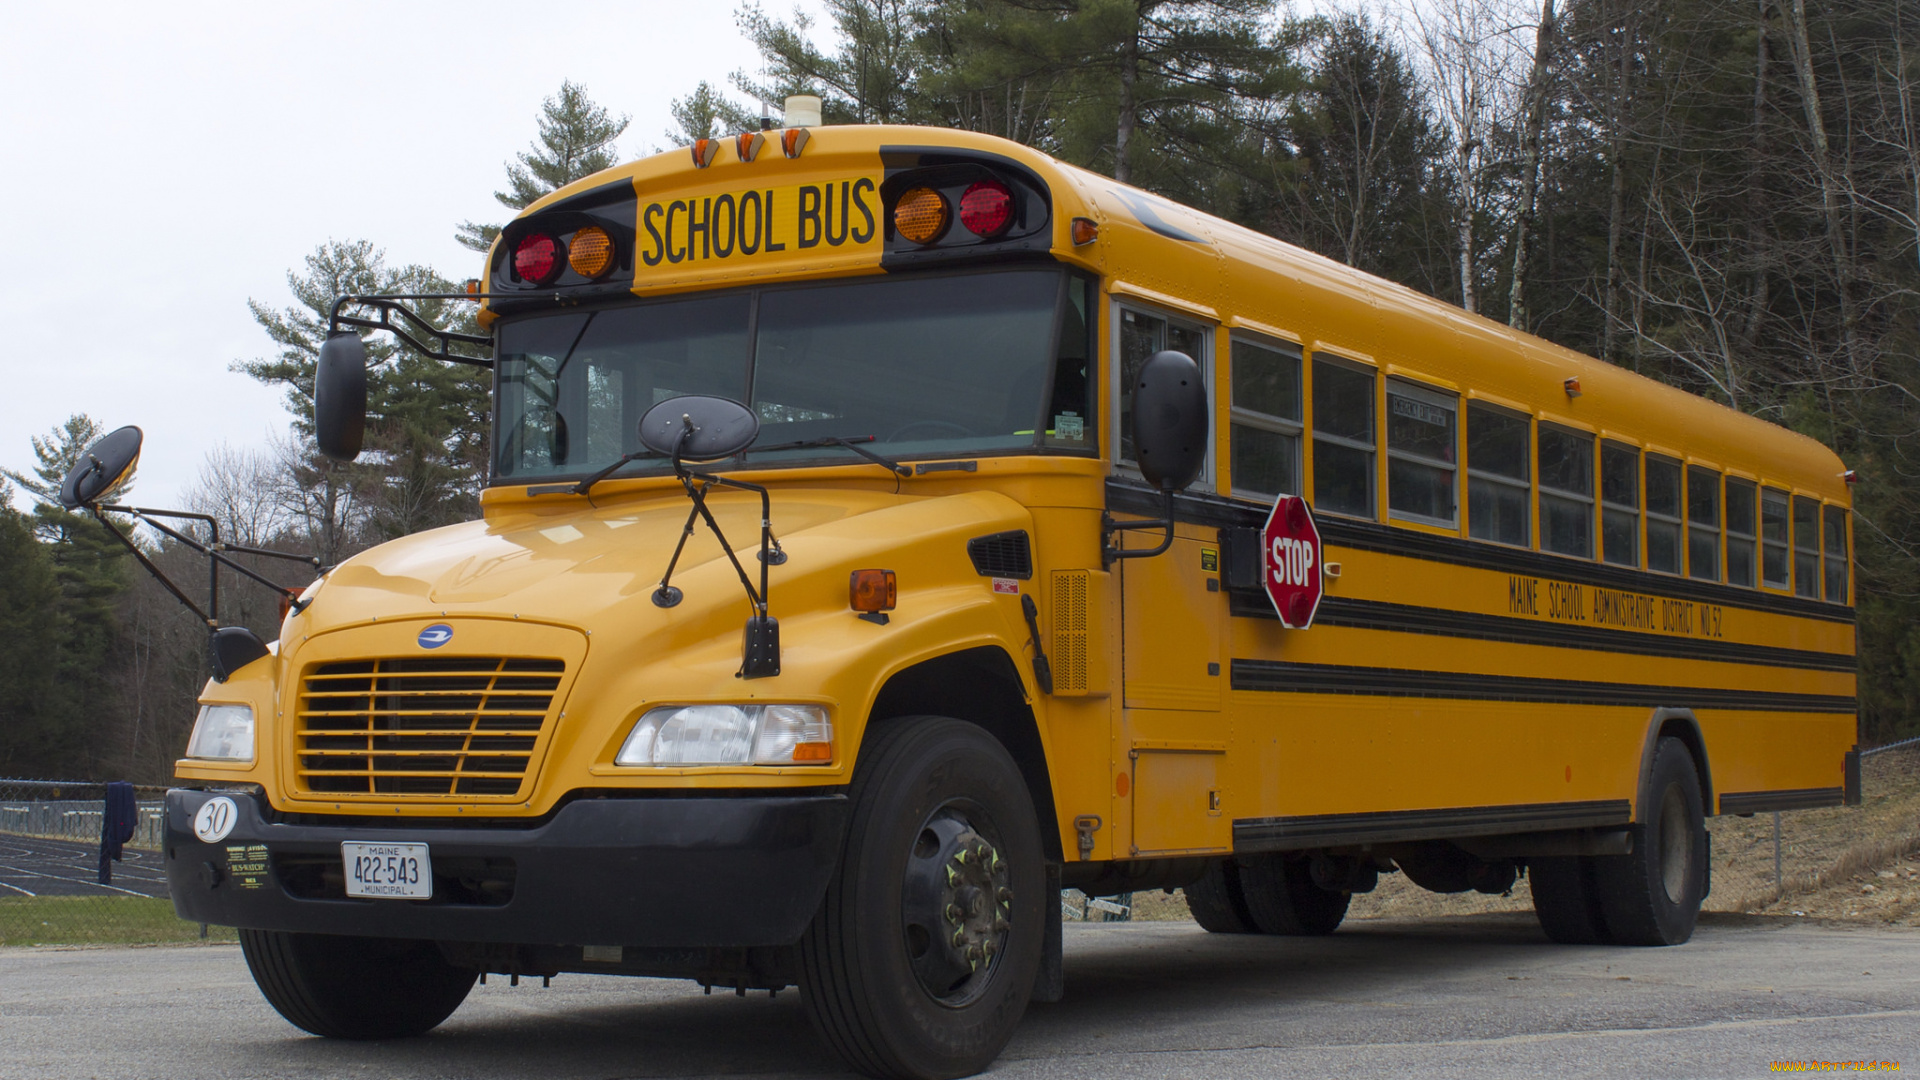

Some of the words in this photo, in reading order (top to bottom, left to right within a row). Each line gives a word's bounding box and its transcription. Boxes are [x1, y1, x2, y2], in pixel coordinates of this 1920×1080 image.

[642, 189, 786, 267] SCHOOL
[798, 177, 876, 250] BUS
[1272, 536, 1314, 588] STOP
[1509, 575, 1539, 616] MAINE
[1548, 581, 1586, 621] SCHOOL
[1593, 588, 1656, 630] ADMINISTRATIVE
[1662, 599, 1694, 635] DISTRICT
[1712, 606, 1723, 638] 52
[199, 802, 229, 836] 30
[369, 847, 400, 856] MAINE
[364, 885, 408, 896] MUNICIPAL
